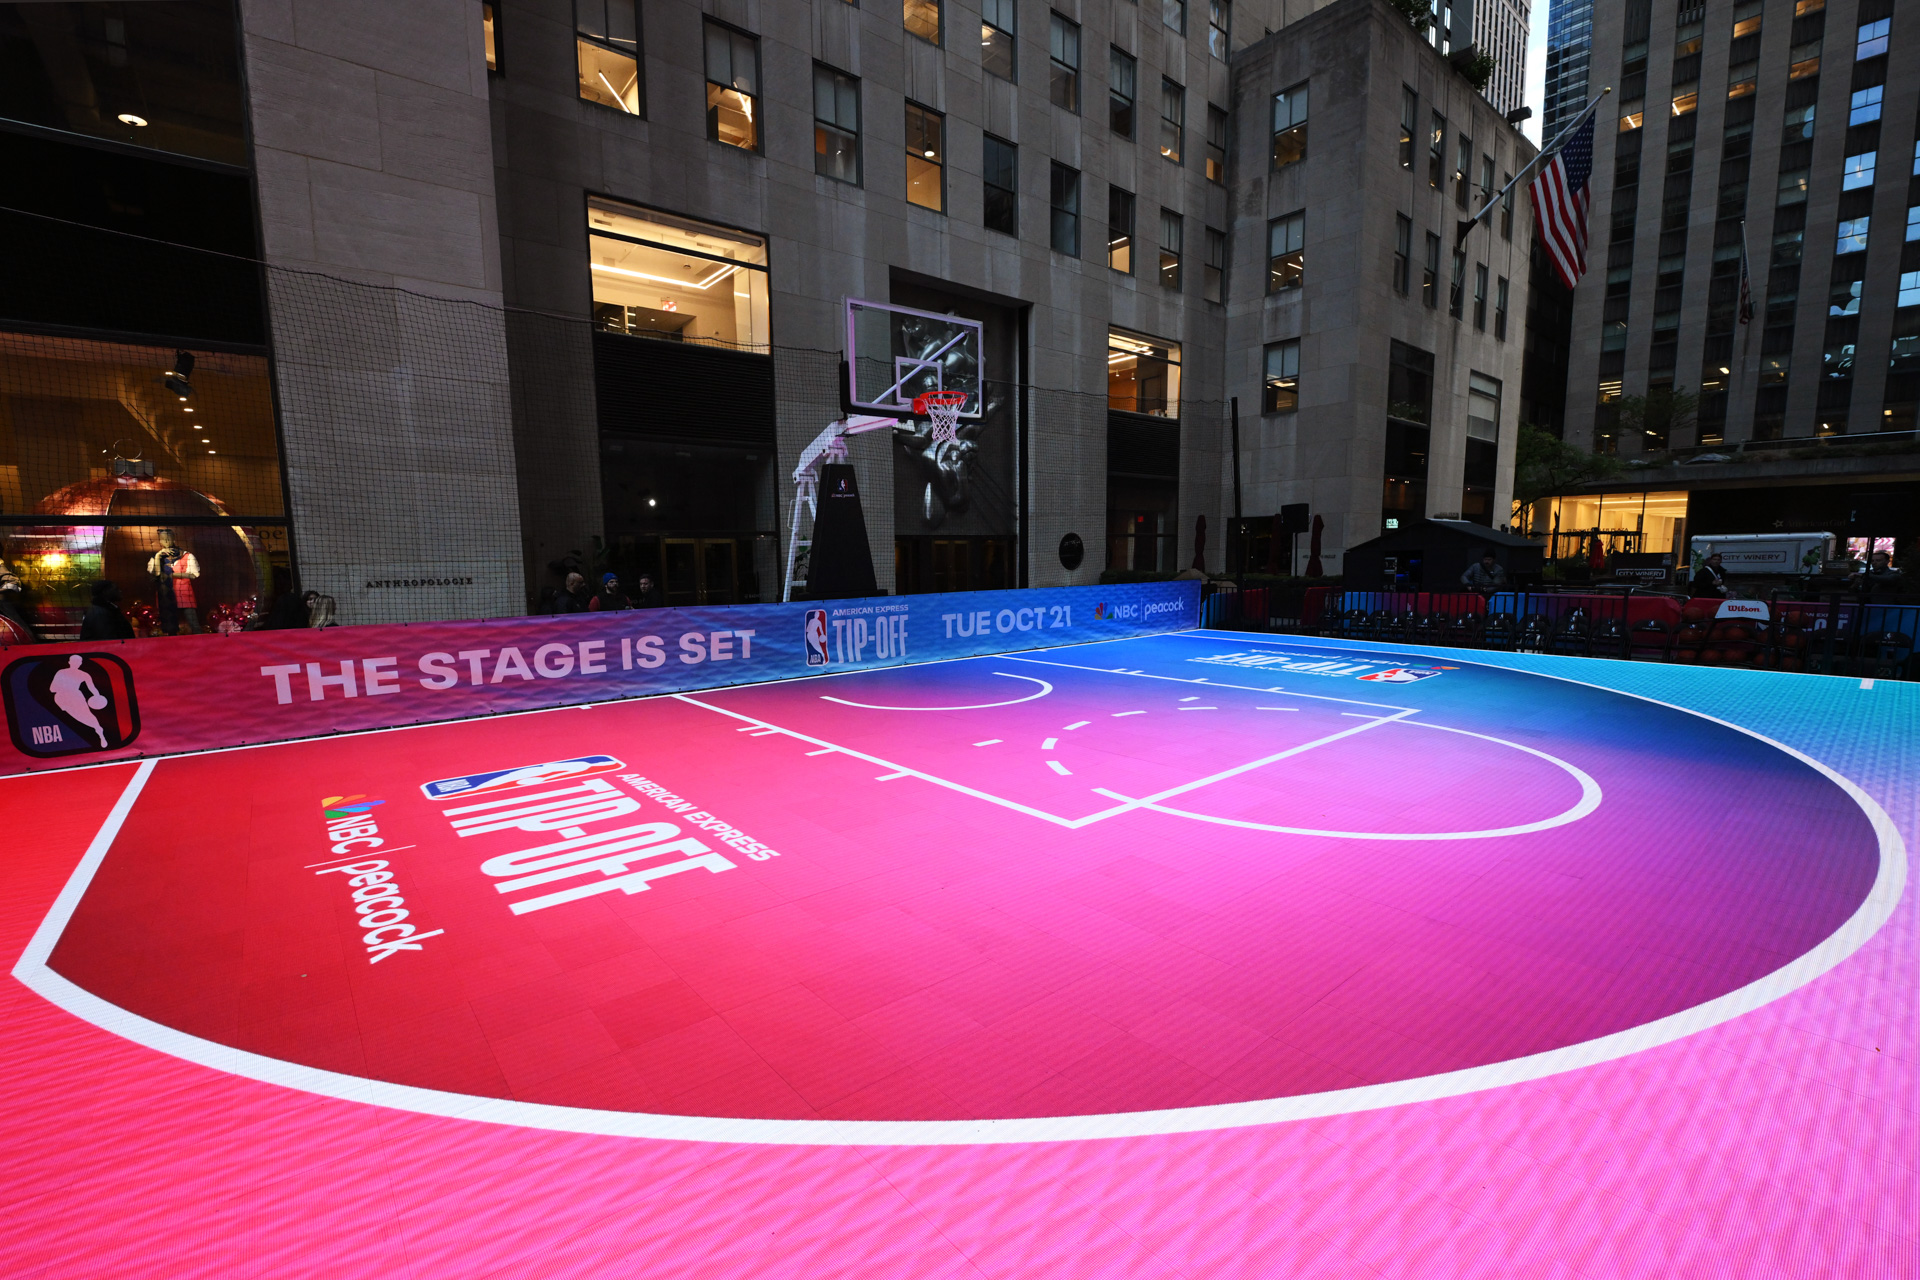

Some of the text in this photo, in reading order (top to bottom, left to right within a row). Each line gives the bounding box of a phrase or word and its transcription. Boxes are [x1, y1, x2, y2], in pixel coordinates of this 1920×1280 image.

[366, 577, 473, 588] ANTHROPOLOGIE
[832, 604, 909, 617] AMERICAN EXPRESS
[941, 605, 1072, 639] TUE OCT 21
[1114, 597, 1184, 619] NBC peacock
[1727, 605, 1761, 613] Wilson
[832, 614, 909, 664] TIP-OFF
[260, 629, 756, 705] THE STAGE IS SET
[1194, 652, 1375, 676] TIP-OFF
[32, 725, 63, 745] NBA
[617, 773, 781, 862] AMERICAN EXPRESS
[442, 778, 738, 915] TIP-OFF
[315, 813, 445, 965] NBC peacock
